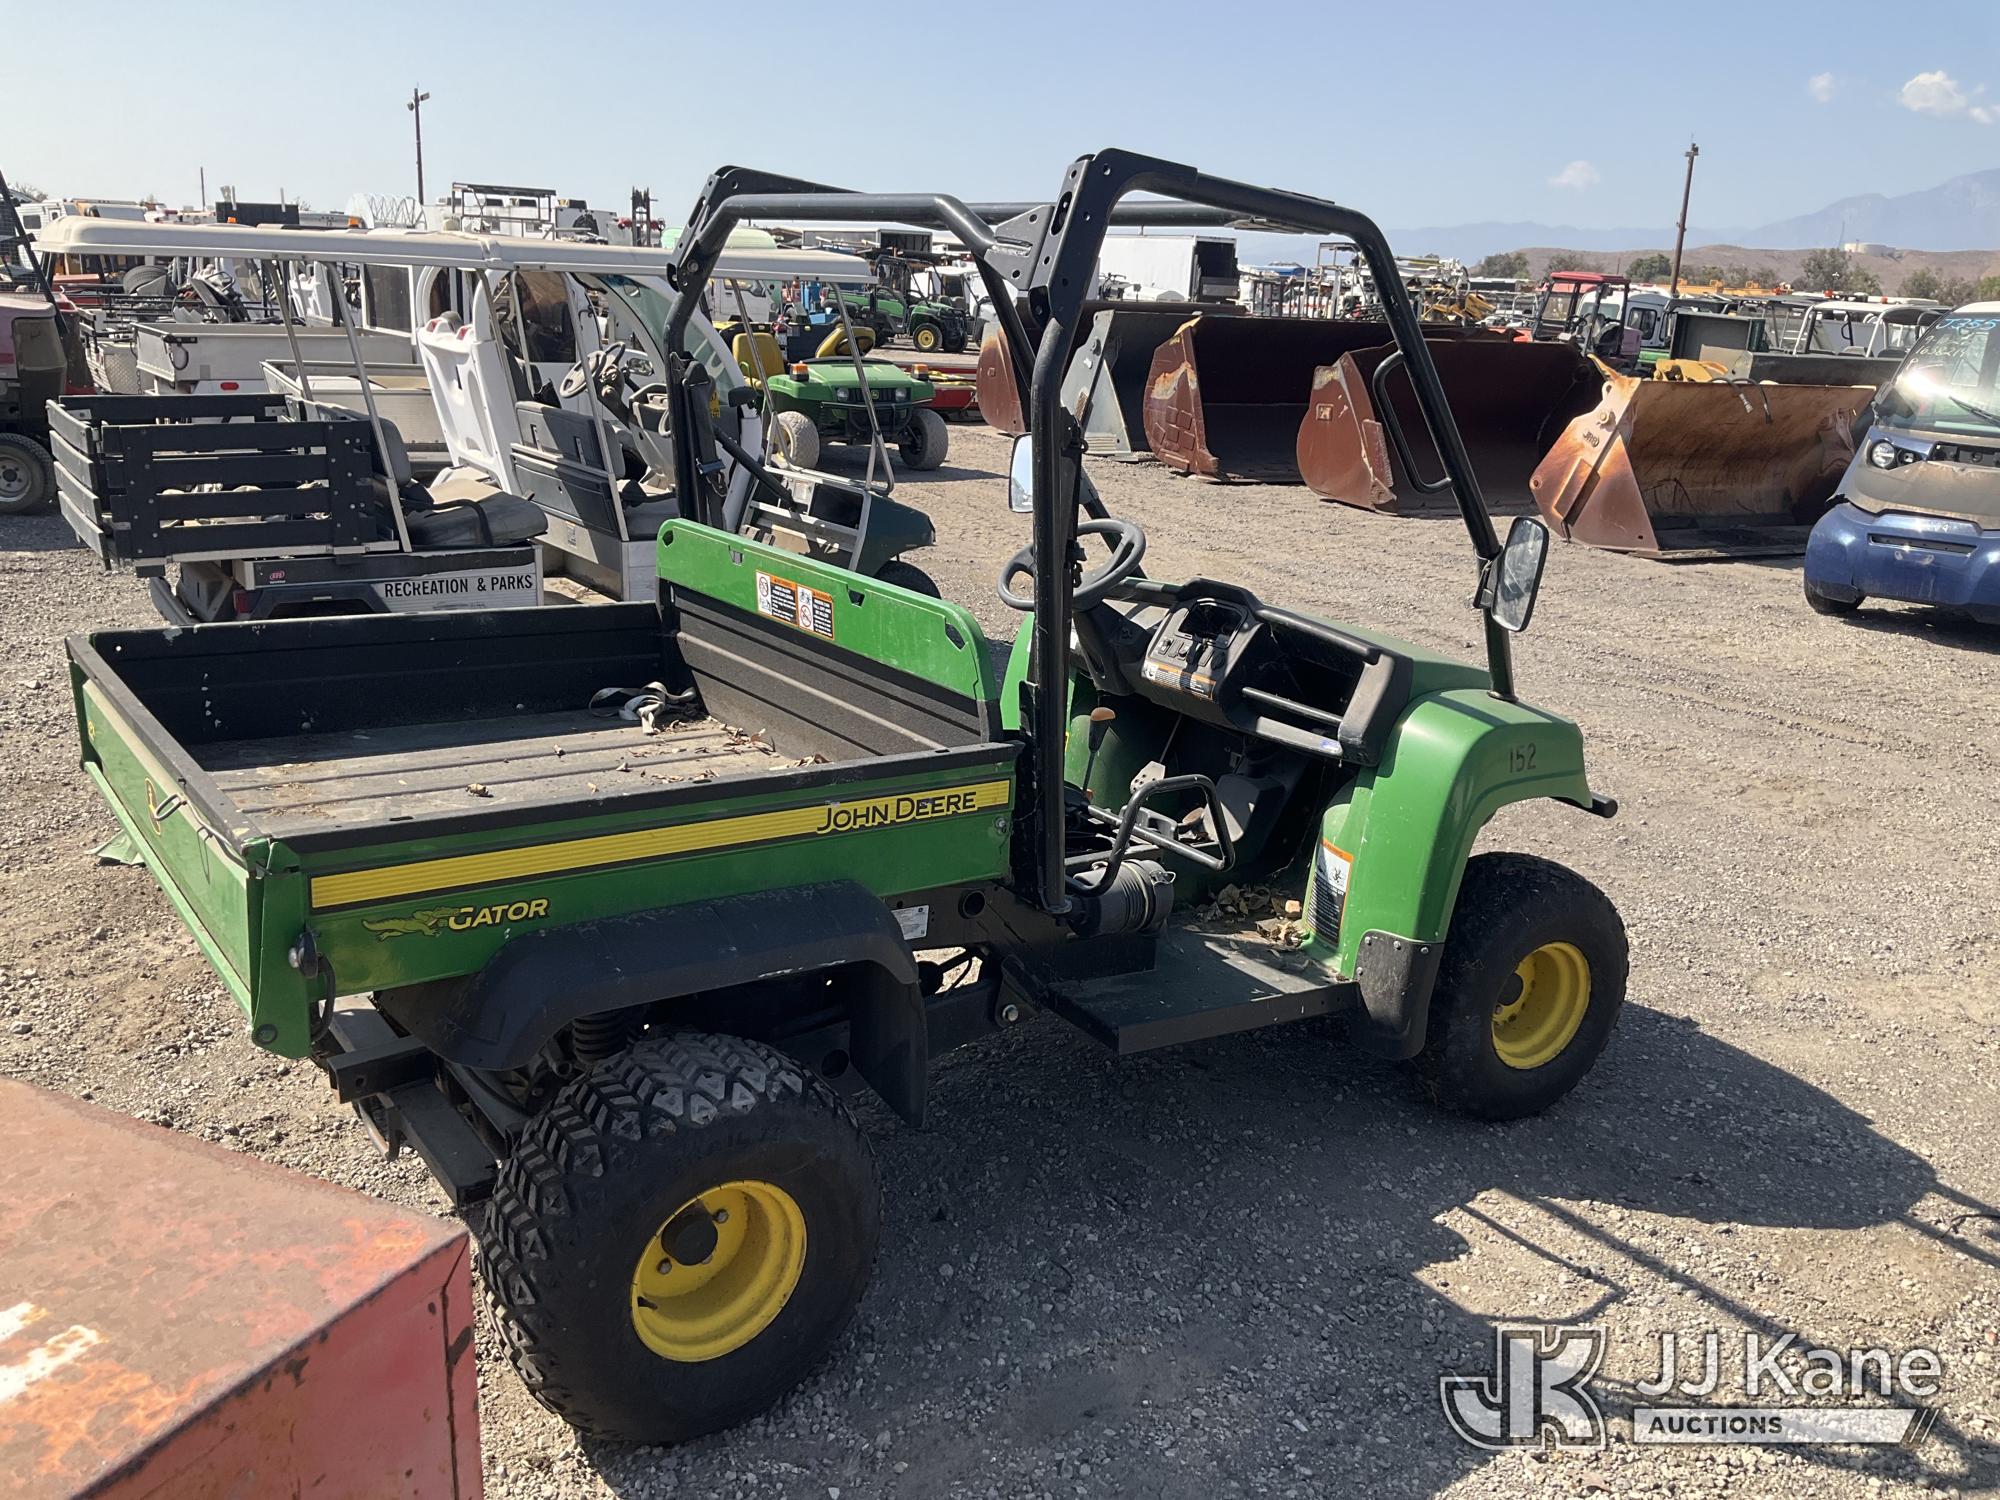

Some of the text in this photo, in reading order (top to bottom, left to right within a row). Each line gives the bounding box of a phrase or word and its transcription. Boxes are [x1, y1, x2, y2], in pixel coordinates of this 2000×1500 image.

[384, 574, 533, 597] RECREATION & PARKS
[1509, 742, 1537, 774] 152
[817, 784, 978, 835] JOHN DEERE
[448, 898, 548, 930] GATOR
